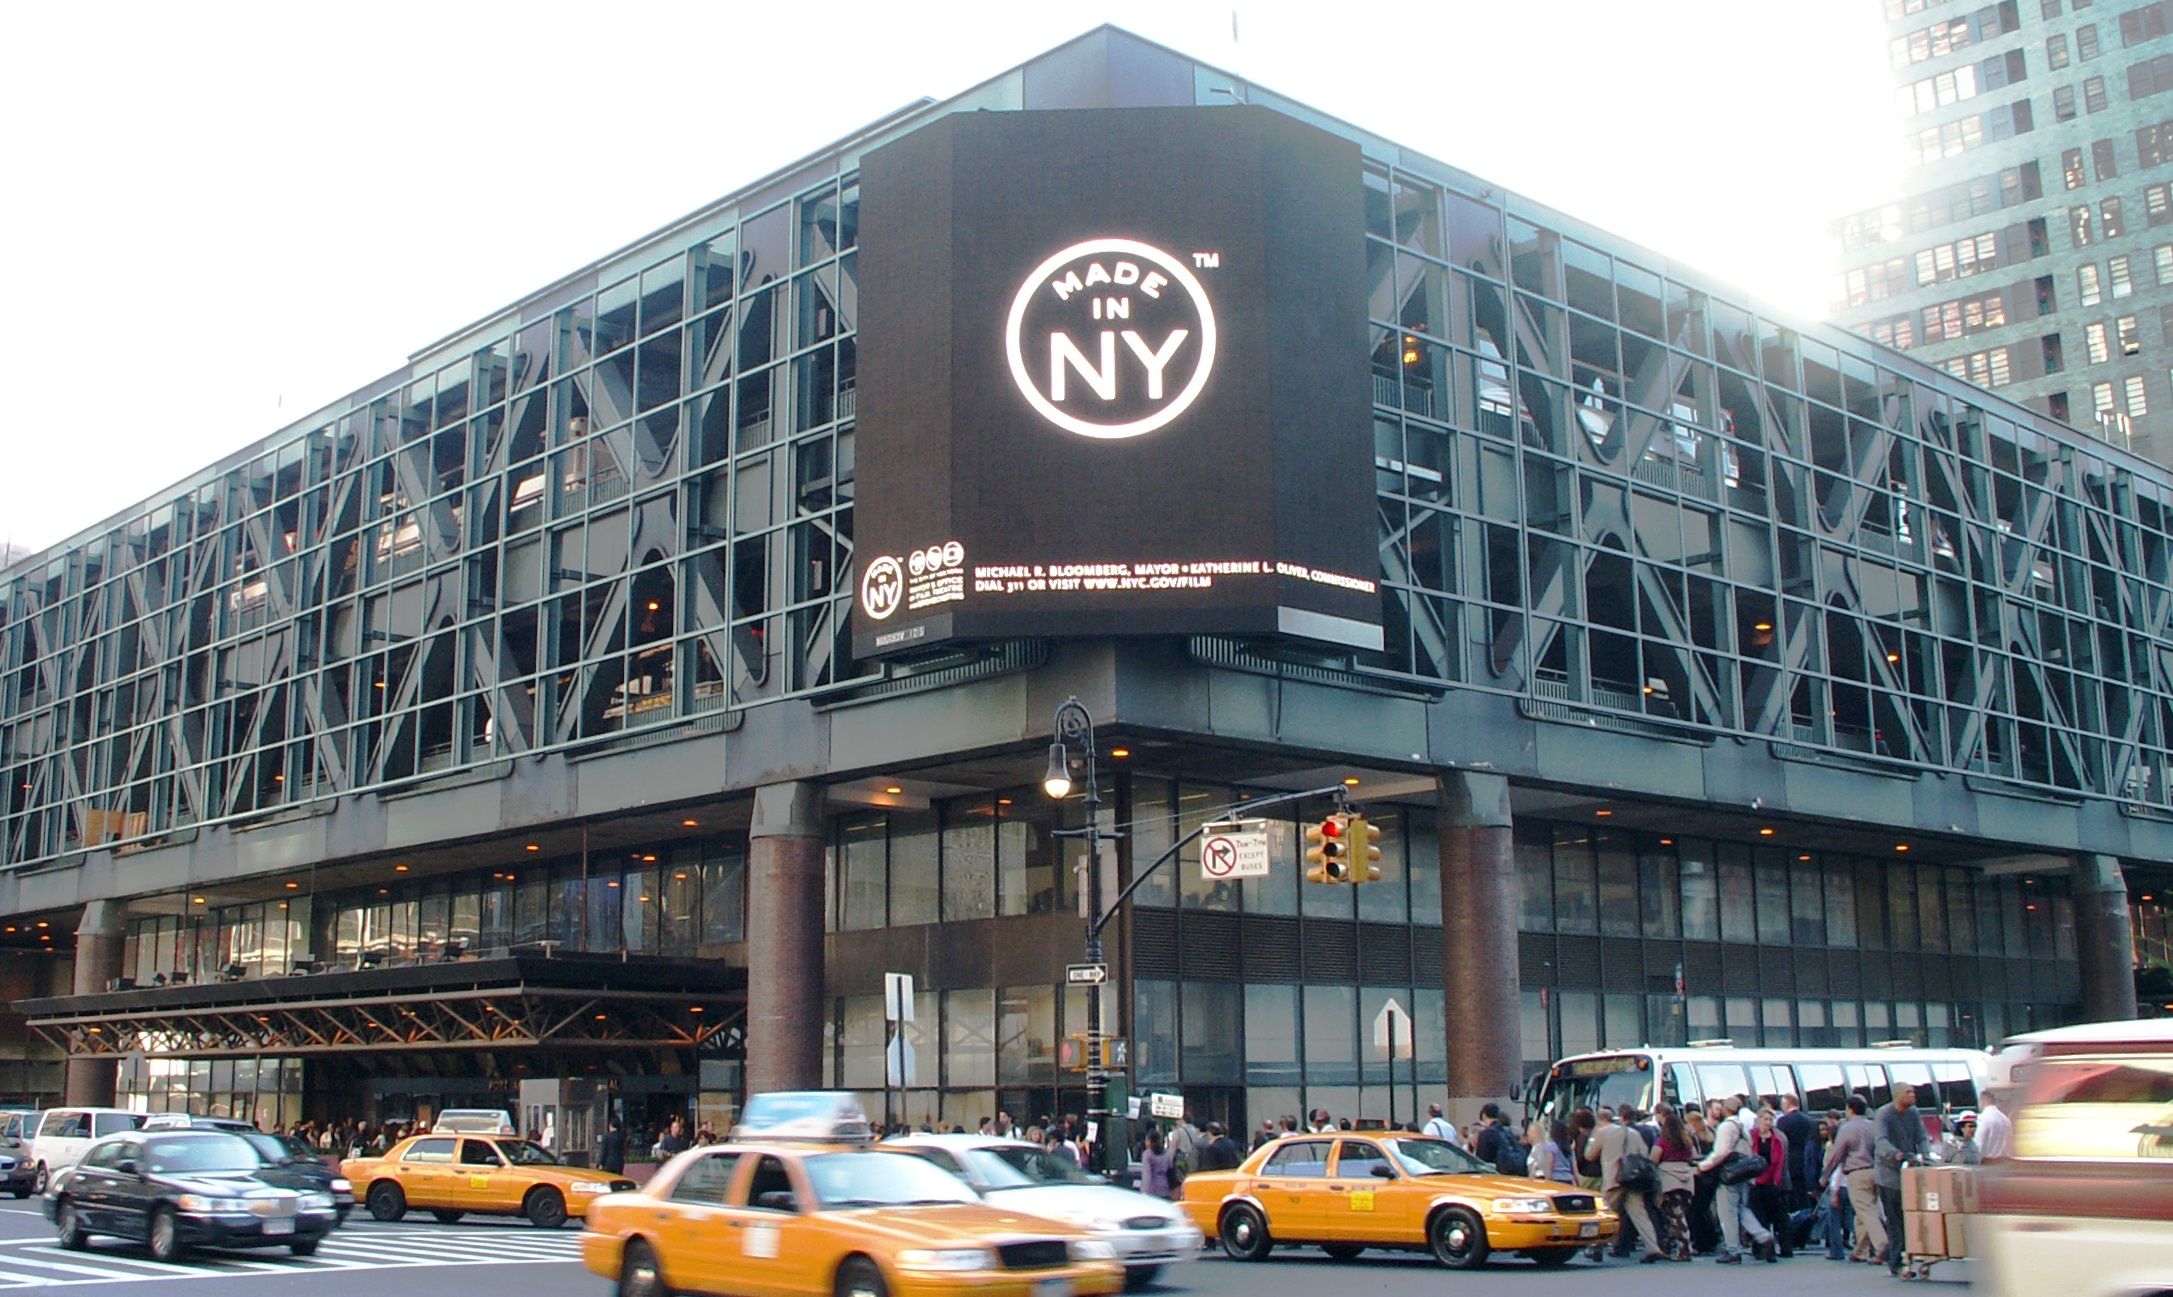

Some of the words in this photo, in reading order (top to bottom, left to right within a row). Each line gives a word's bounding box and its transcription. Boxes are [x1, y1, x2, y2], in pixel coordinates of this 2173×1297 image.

[1193, 253, 1219, 267] TM
[1052, 261, 1167, 300] MADE
[1093, 297, 1129, 319] IN
[1051, 329, 1188, 401] NY
[975, 566, 1031, 578] MICHAEL
[1034, 566, 1046, 577] R.
[1050, 564, 1131, 577] BLOOMBERG,
[1135, 563, 1179, 575] MAYOR
[1190, 562, 1260, 574] KATHERINE
[1262, 561, 1274, 573] L.
[1276, 562, 1310, 581] OLIVER,
[1311, 569, 1376, 593] COMMISSIONER
[975, 579, 1004, 592] DIAL
[1007, 581, 1024, 593] 311
[1027, 579, 1047, 590] OR
[1050, 578, 1081, 589] VISIT
[1083, 576, 1212, 589] WWW.NYC.GOV/FILM
[869, 581, 897, 609] NY
[1239, 851, 1264, 860] EXCEPT
[1241, 863, 1263, 871] BUSES
